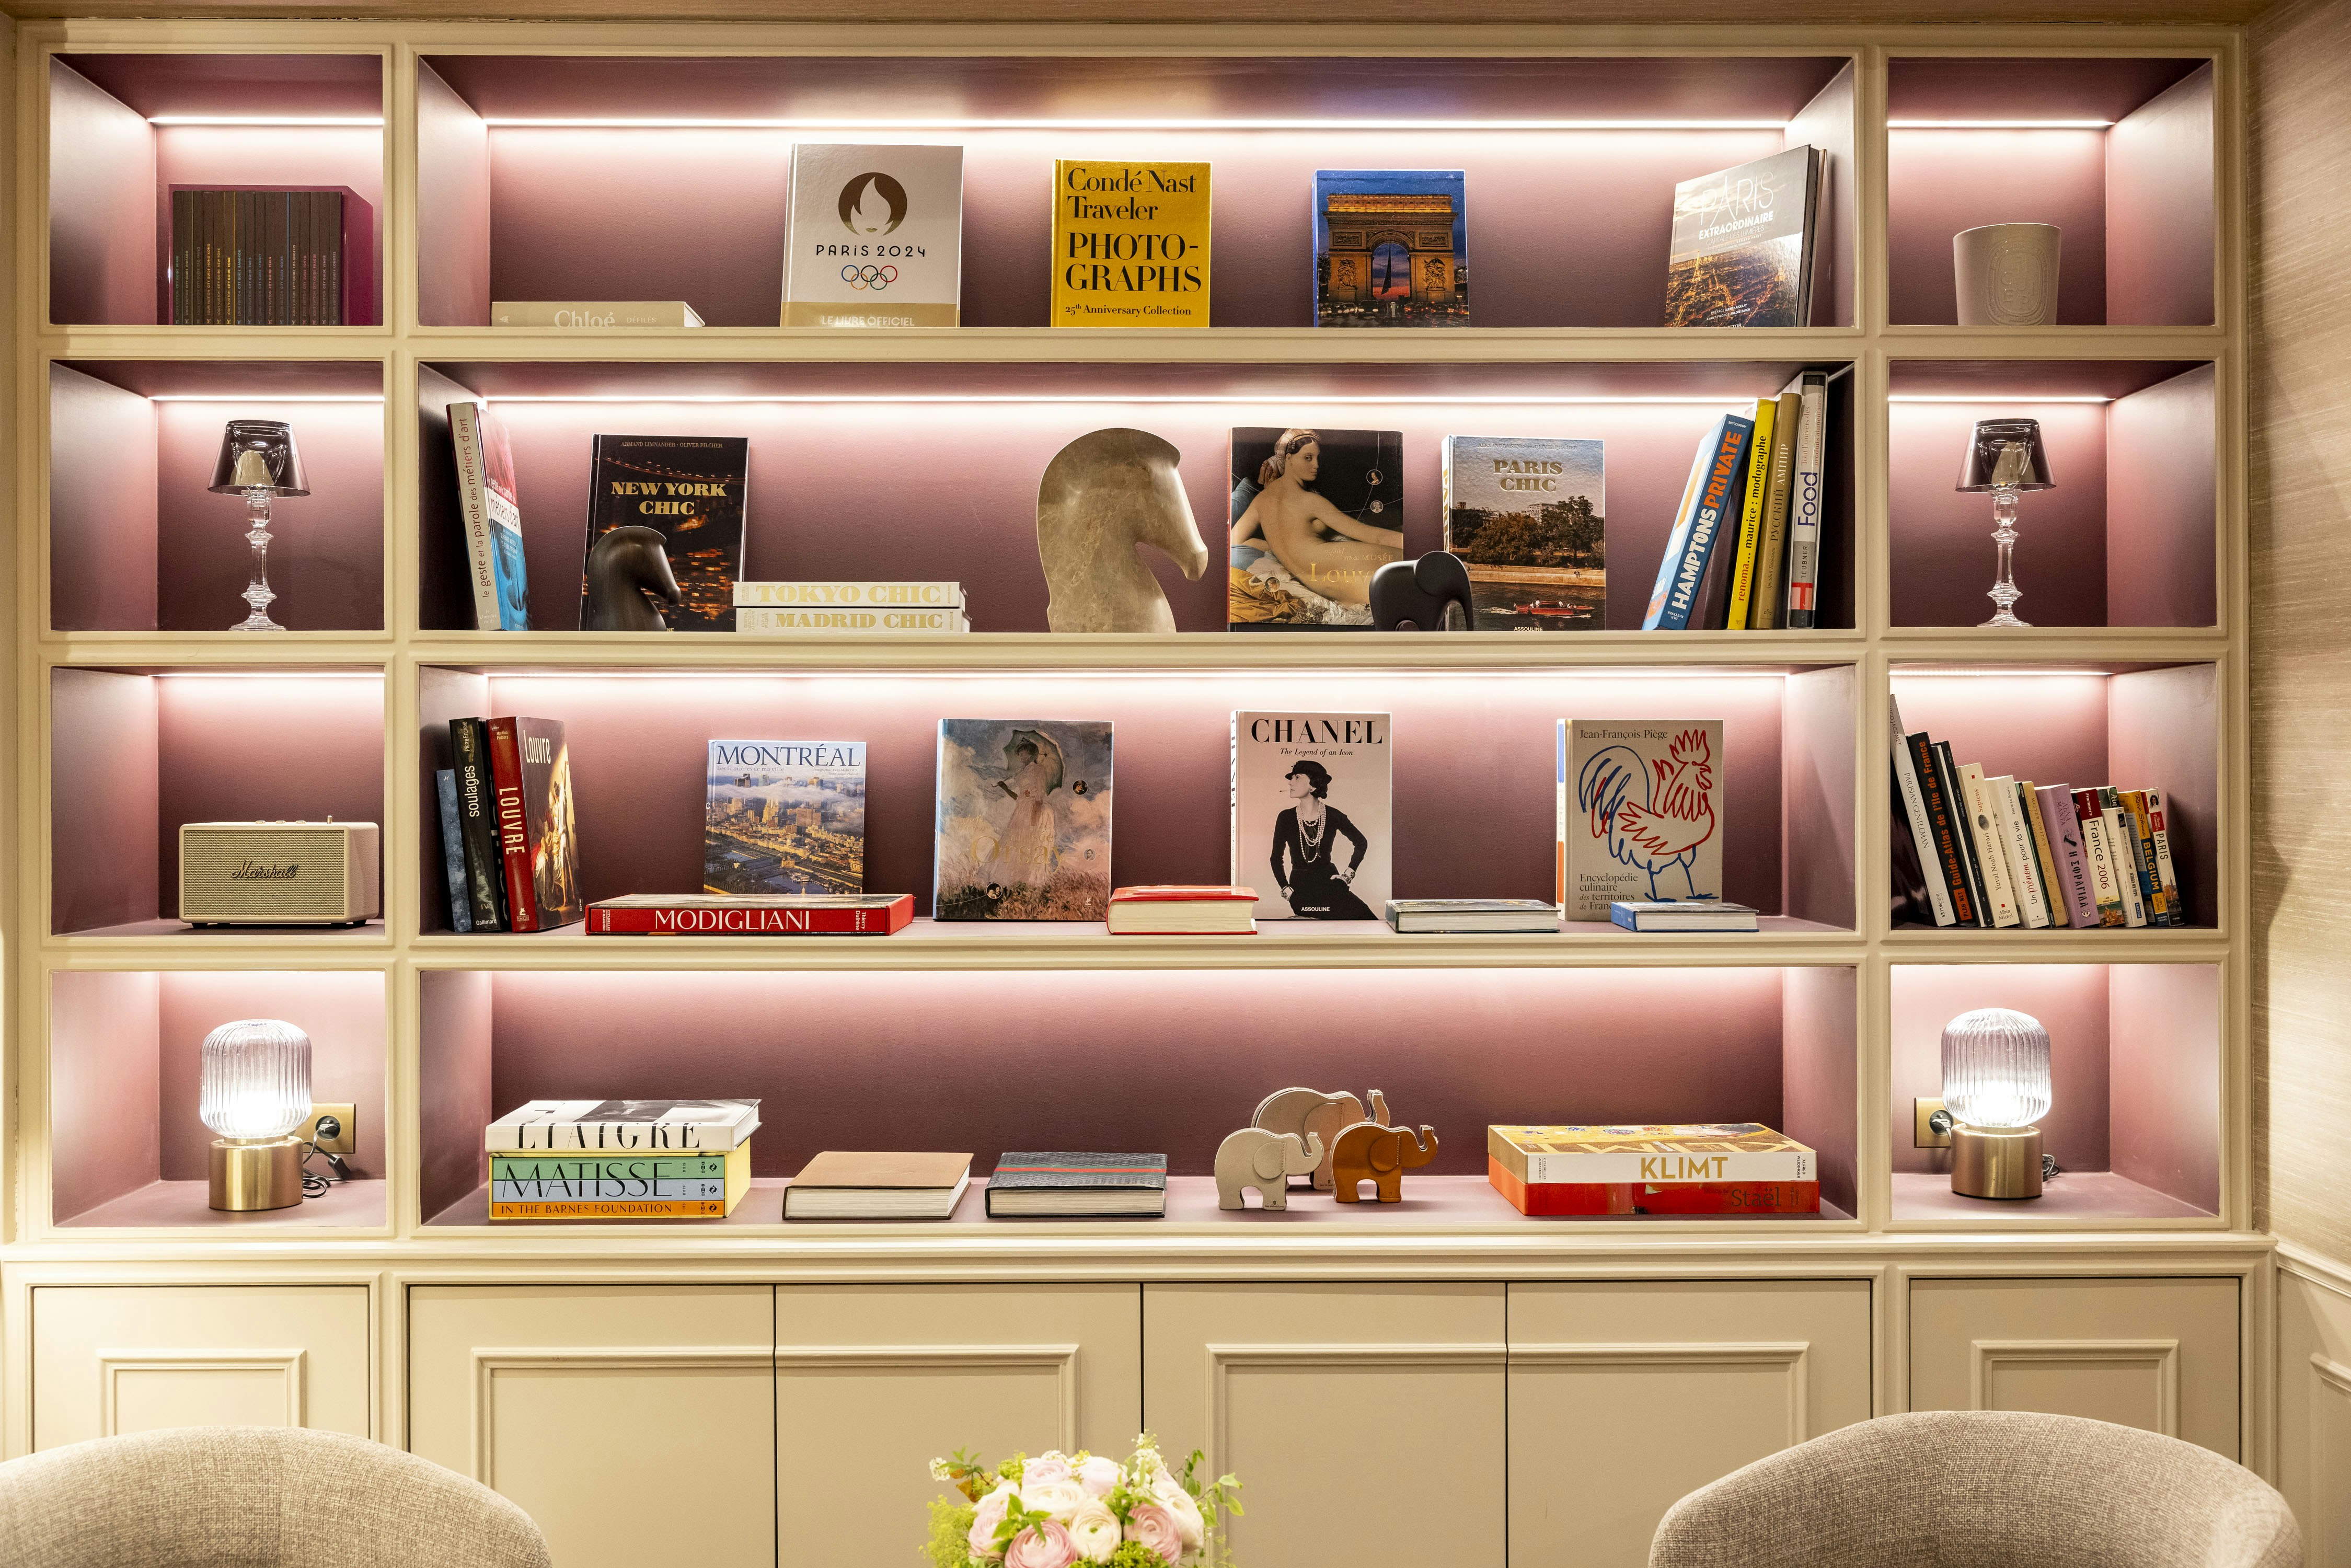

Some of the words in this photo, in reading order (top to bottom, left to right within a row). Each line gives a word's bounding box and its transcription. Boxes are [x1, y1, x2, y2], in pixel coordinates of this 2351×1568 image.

[1068, 168, 1142, 192] Condé
[1146, 170, 1196, 193] Nast
[1067, 195, 1158, 220] Traveler
[1700, 171, 1774, 228] PARIS
[1699, 211, 1773, 240] EXTRAORDINAIRE
[816, 245, 869, 256] PARIS
[877, 245, 925, 257] 2024
[1066, 232, 1198, 260] PHOTO-
[1706, 234, 1728, 246] CAPITALE
[1066, 263, 1202, 292] GRAPHS
[554, 310, 615, 327] Chloé
[822, 316, 833, 325] LE
[835, 316, 864, 326] LIVRE
[868, 316, 914, 326] OFFICIEL
[1066, 304, 1081, 316] 25th
[1083, 305, 1142, 317] Anniversary
[1143, 305, 1191, 315] Collection
[458, 418, 470, 442] d'art
[463, 445, 477, 485] métiers
[1493, 460, 1563, 475] PARIS
[610, 482, 660, 495] NEW
[664, 483, 727, 497] YORK
[1500, 478, 1557, 492] CHIC
[1745, 508, 1757, 549] maurice
[1751, 435, 1767, 499] modographe
[1770, 489, 1784, 541] РУССКИЙ
[1777, 443, 1790, 486] АМПИР
[639, 501, 695, 515] CHIC
[1797, 472, 1818, 526] Food
[469, 504, 485, 538] parole
[1672, 508, 1716, 609] HAMPTONS
[1704, 431, 1742, 509] PRIVATE
[478, 560, 491, 586] geste
[1309, 562, 1374, 582] Louv
[756, 585, 861, 603] TOKYO
[868, 585, 940, 603] CHIC
[775, 614, 877, 628] MADRID
[883, 614, 943, 628] CHIC
[1251, 719, 1382, 744] CHANEL
[1580, 729, 1641, 741] Jean-François
[1644, 729, 1668, 741] Piège
[523, 730, 551, 765] Louvre
[716, 743, 861, 767] MONTRÉAL
[1294, 748, 1318, 757] Legend
[1320, 748, 1327, 757] of
[1919, 741, 1933, 774] France
[464, 765, 479, 817] soulages
[1927, 777, 1937, 789] de
[1904, 773, 1917, 804] PARISIAN
[1913, 804, 1929, 848] GENTLEMAN
[1975, 789, 1984, 813] Sapiens
[499, 787, 525, 855] LOUVRE
[1937, 814, 1946, 826] de
[971, 835, 1063, 875] Orsay
[1983, 833, 1993, 855] Harari
[2019, 843, 2030, 861] pour
[2089, 820, 2104, 861] France
[2097, 864, 2110, 890] 2006
[2156, 833, 2168, 860] PARIS
[231, 859, 299, 878] Marshall
[1941, 829, 1963, 886] Guide-Atlas
[1988, 855, 1998, 874] Noah
[2143, 841, 2160, 890] BELGIUM
[1580, 873, 1638, 884] Encyclopédie
[1580, 883, 1618, 892] culinaire
[1992, 875, 2001, 891] Yuval
[2023, 862, 2035, 893] prénom
[1590, 902, 1611, 910] Fran
[1592, 892, 1634, 901] territoires
[1936, 893, 1945, 918] INTERVALLES
[2031, 894, 2037, 904] Un
[655, 909, 810, 930] MODIGLIANI
[515, 1123, 702, 1149] LIAIGRE
[502, 1162, 673, 1198] MATISSE
[1641, 1157, 1728, 1179] KLIMT
[1732, 1186, 1781, 1207] Staël
[501, 1205, 513, 1214] IN
[518, 1205, 540, 1214] THE
[546, 1204, 589, 1214] BARNES
[595, 1204, 672, 1214] FOUNDATION
